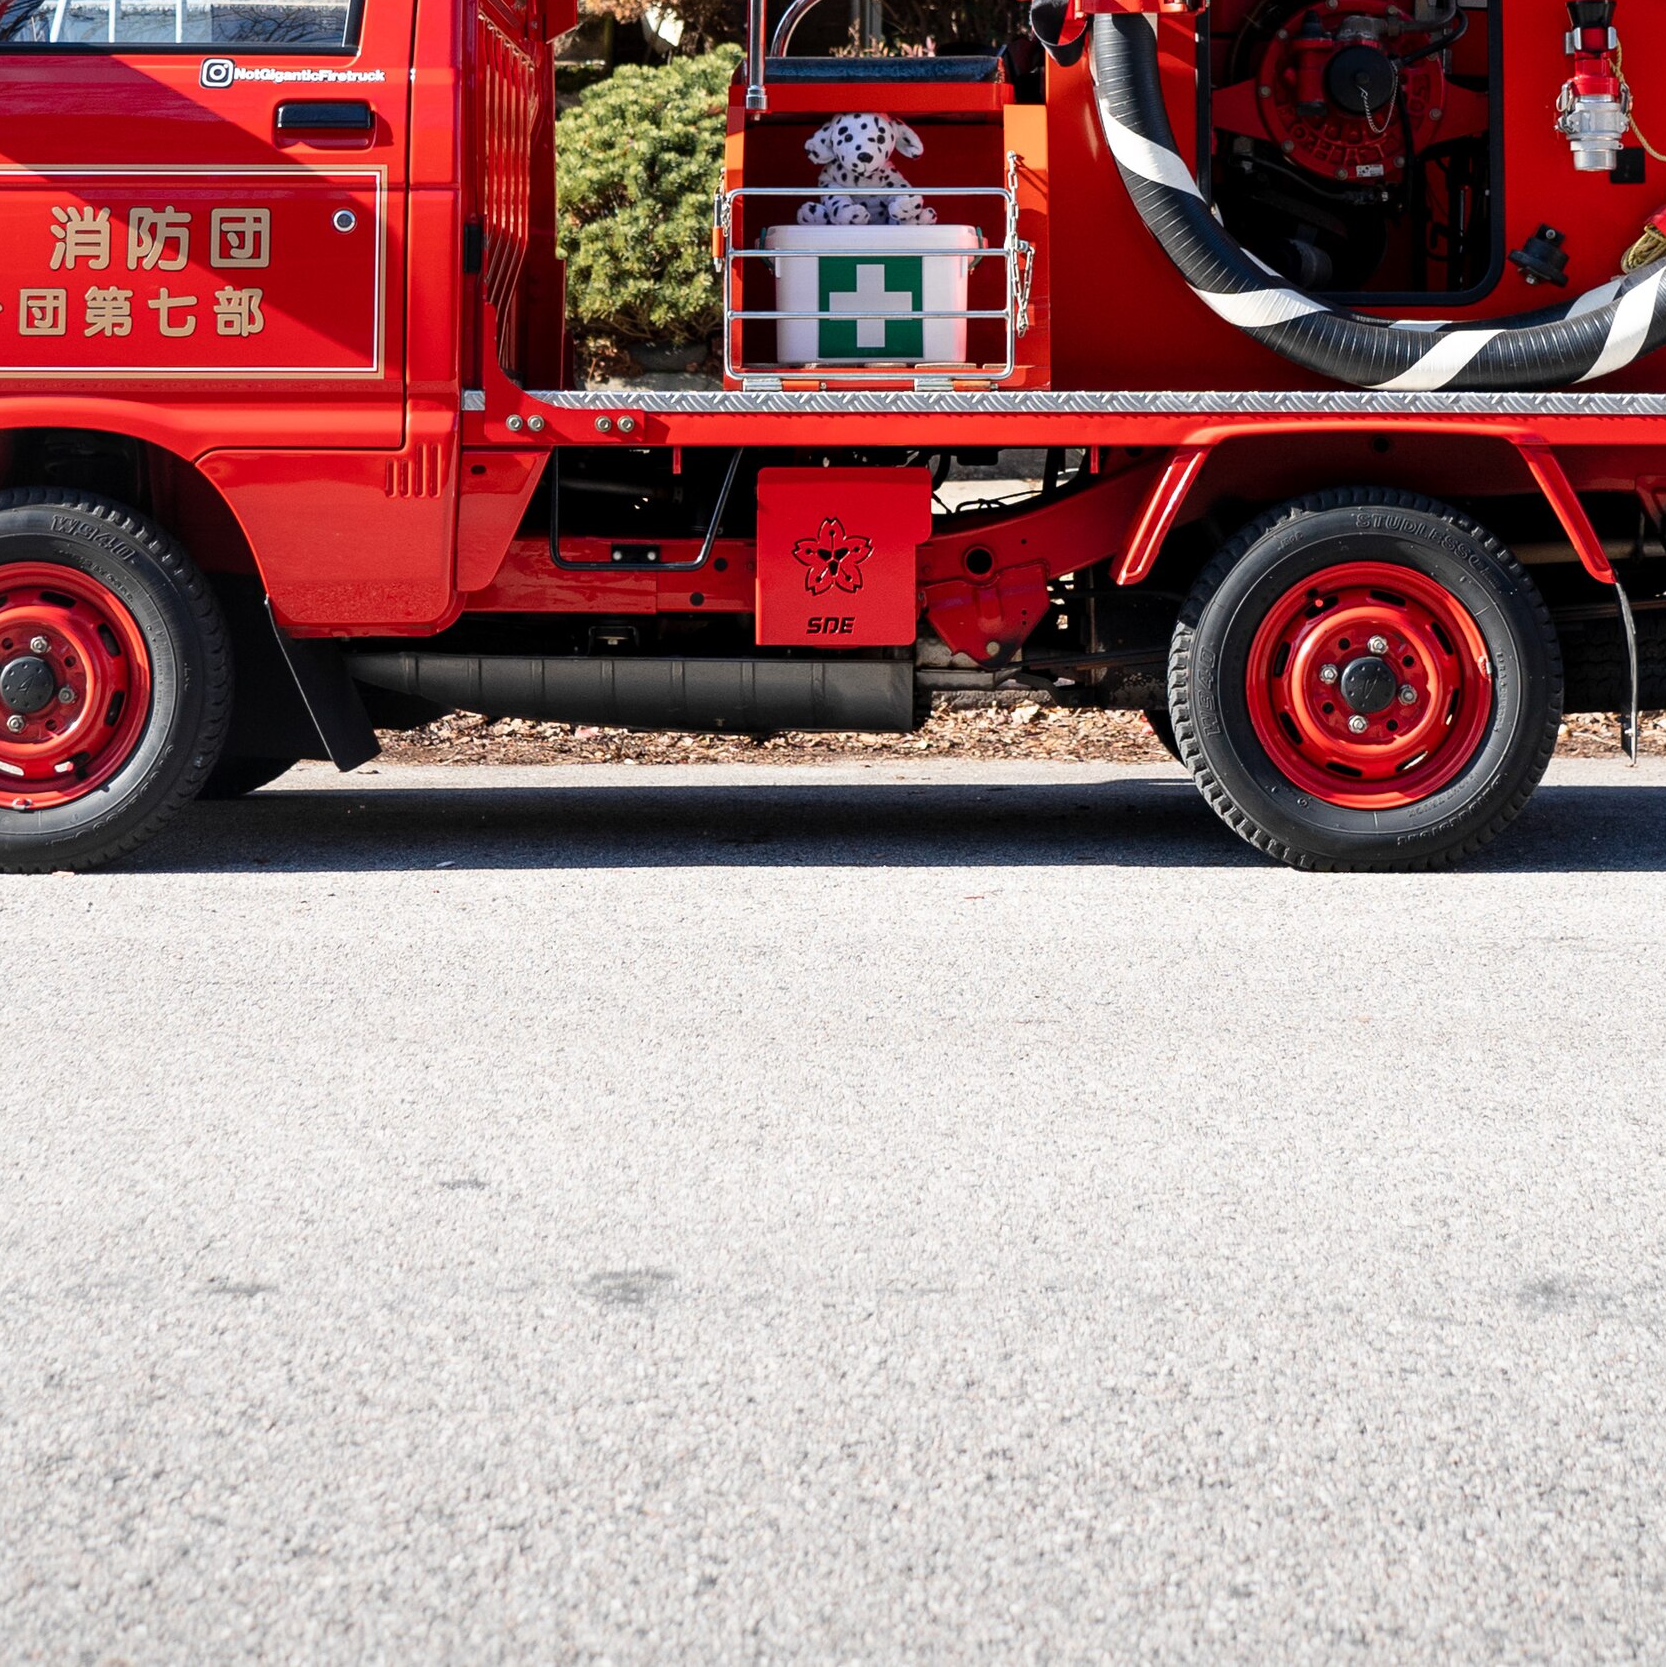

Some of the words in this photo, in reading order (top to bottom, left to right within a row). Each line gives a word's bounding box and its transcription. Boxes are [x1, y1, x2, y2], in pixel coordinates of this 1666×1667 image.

[234, 67, 386, 83] NotGiganticFiretruck
[49, 205, 271, 271] 消防団
[50, 514, 135, 560] W940
[806, 617, 855, 634] SDE
